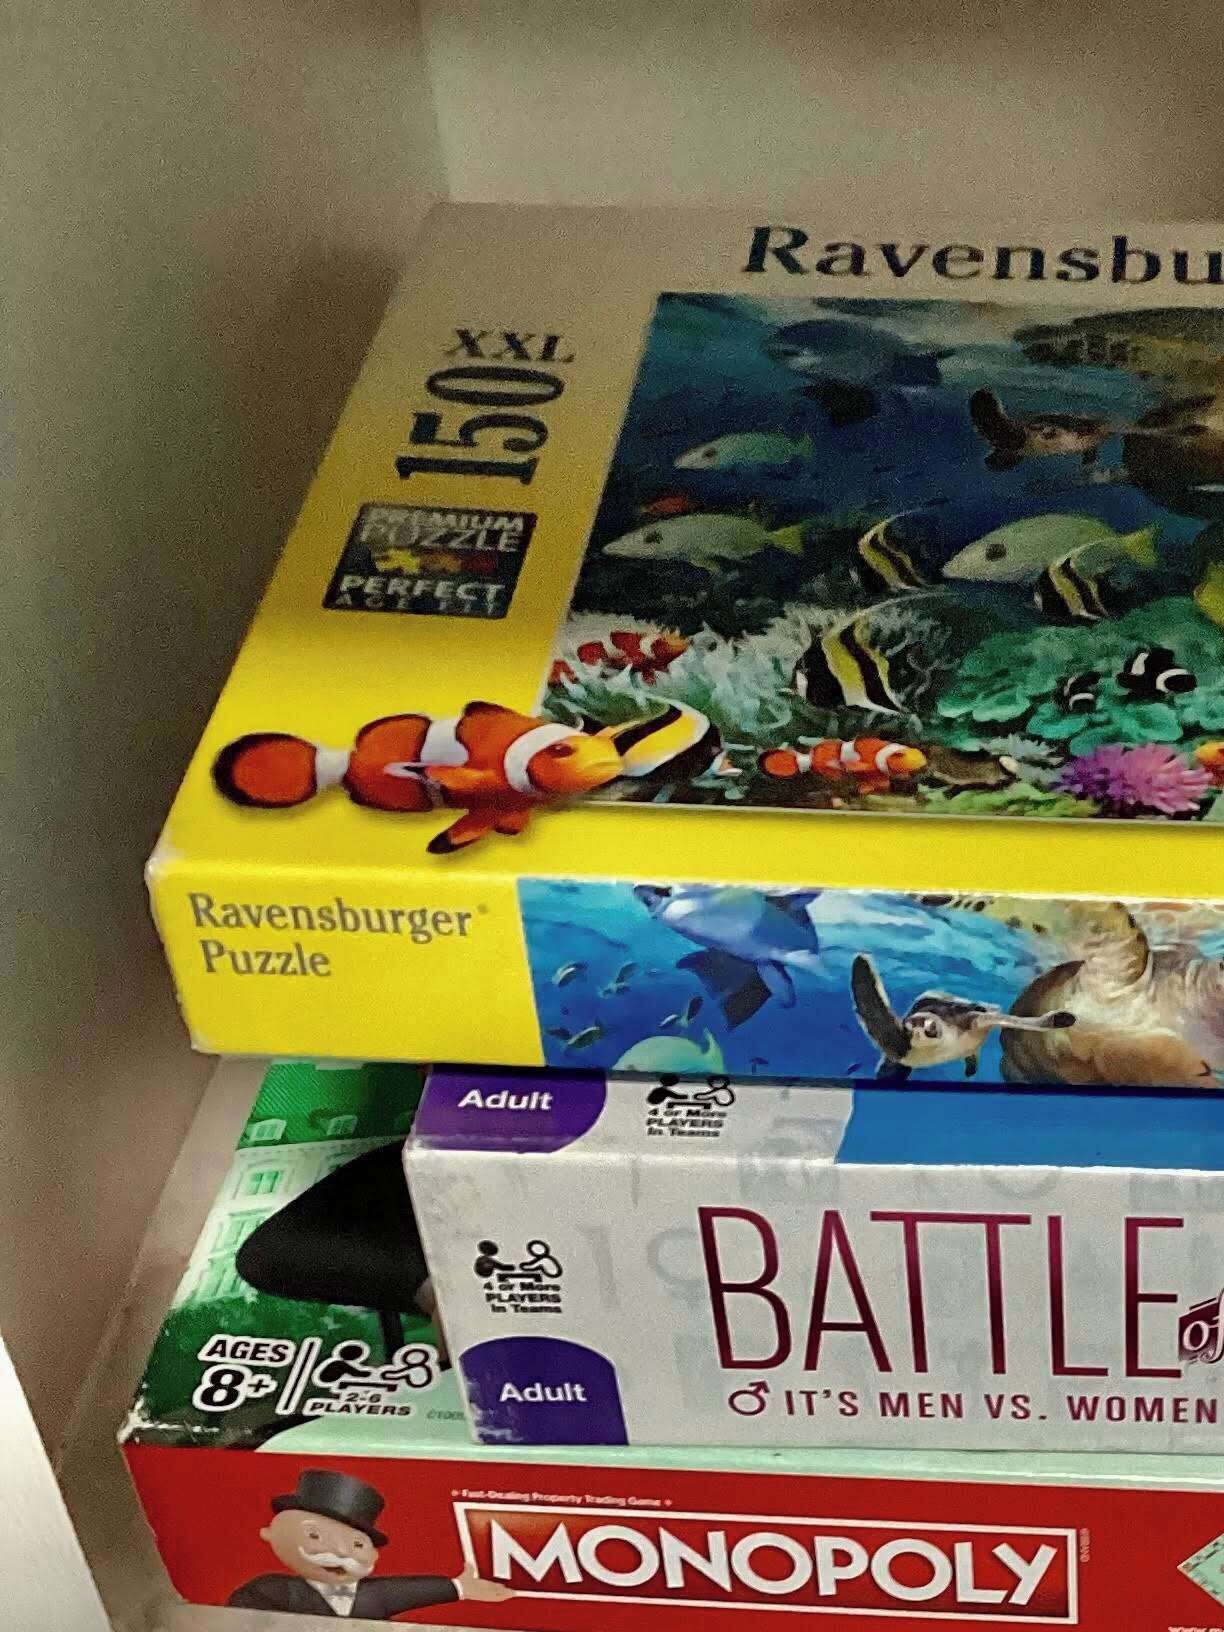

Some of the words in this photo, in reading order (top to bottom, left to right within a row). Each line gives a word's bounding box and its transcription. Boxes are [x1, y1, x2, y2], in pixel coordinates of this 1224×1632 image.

[444, 328, 575, 363] XXL
[396, 365, 565, 485] 150
[340, 574, 506, 600] PERFECT
[188, 892, 472, 944] Ravensburger
[201, 941, 332, 978] Puzzle
[457, 1090, 553, 1111] Adult
[648, 1108, 660, 1117] 4
[646, 1118, 724, 1128] PLAYERS
[483, 1281, 494, 1291] 4
[485, 1293, 562, 1303] PLAYERS
[698, 1206, 1184, 1379] BATTLE
[206, 1339, 289, 1363] AGES
[201, 1368, 272, 1407] 8+
[500, 1382, 587, 1402] Adult
[311, 1402, 411, 1416] PLAYERS
[785, 1389, 859, 1417] IT'S
[880, 1392, 963, 1419] MEN
[984, 1394, 1048, 1421] VS.
[1068, 1395, 1218, 1425] WOMEN
[492, 1518, 1059, 1607] MONOPOLY
